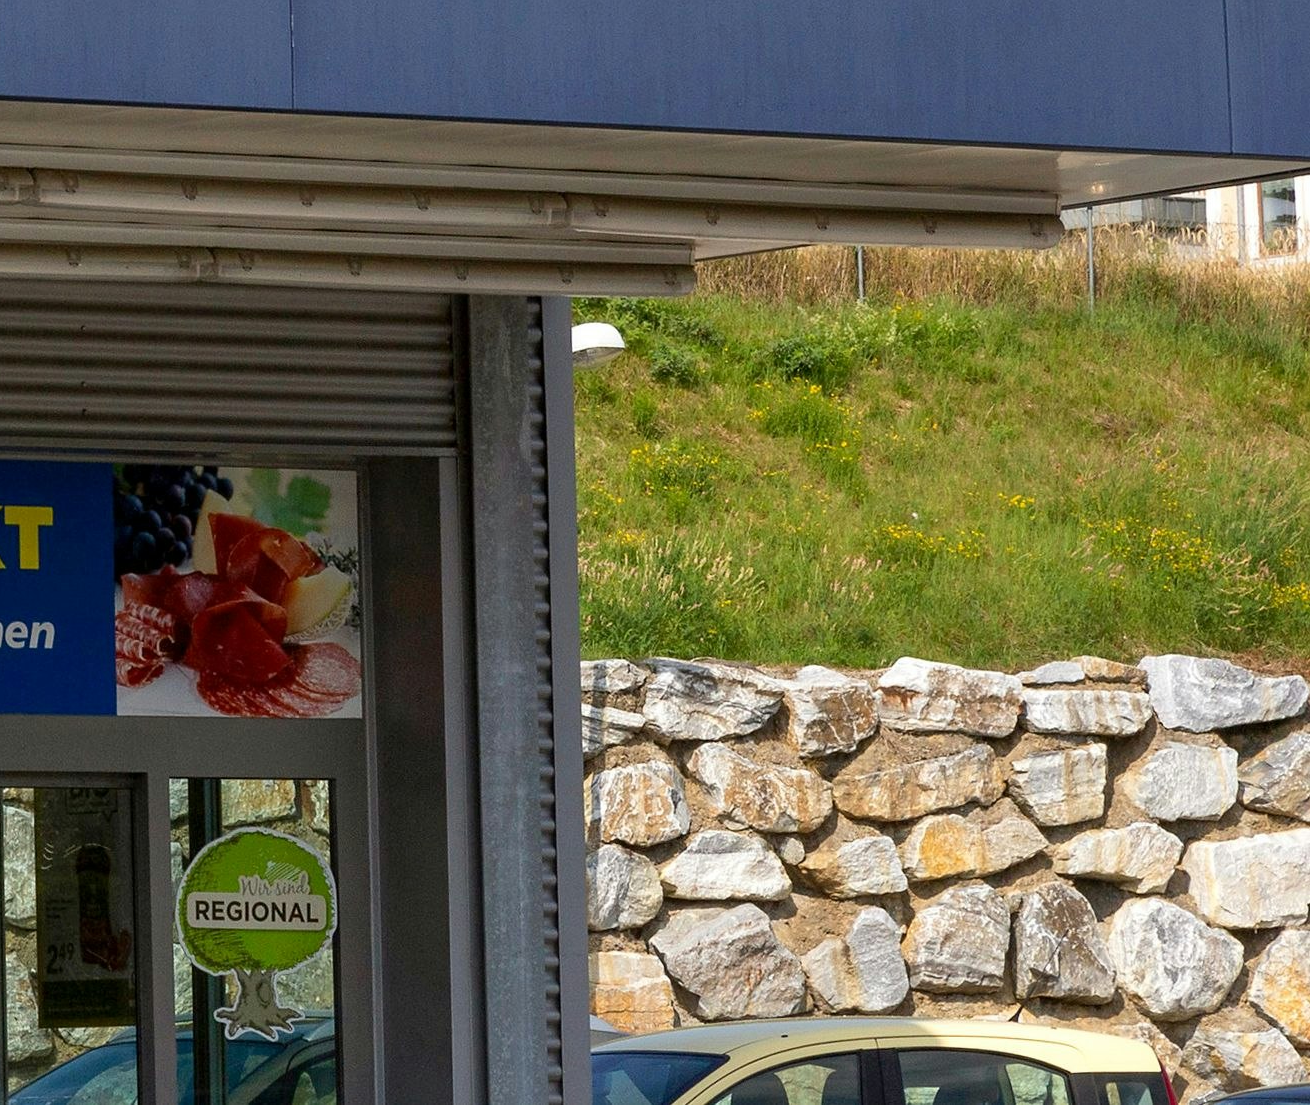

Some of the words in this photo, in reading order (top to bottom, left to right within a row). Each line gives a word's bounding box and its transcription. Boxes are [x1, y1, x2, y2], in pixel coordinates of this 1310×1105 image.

[240, 876, 271, 895] Wir
[274, 872, 309, 896] sind
[194, 900, 319, 923] REGIONAL
